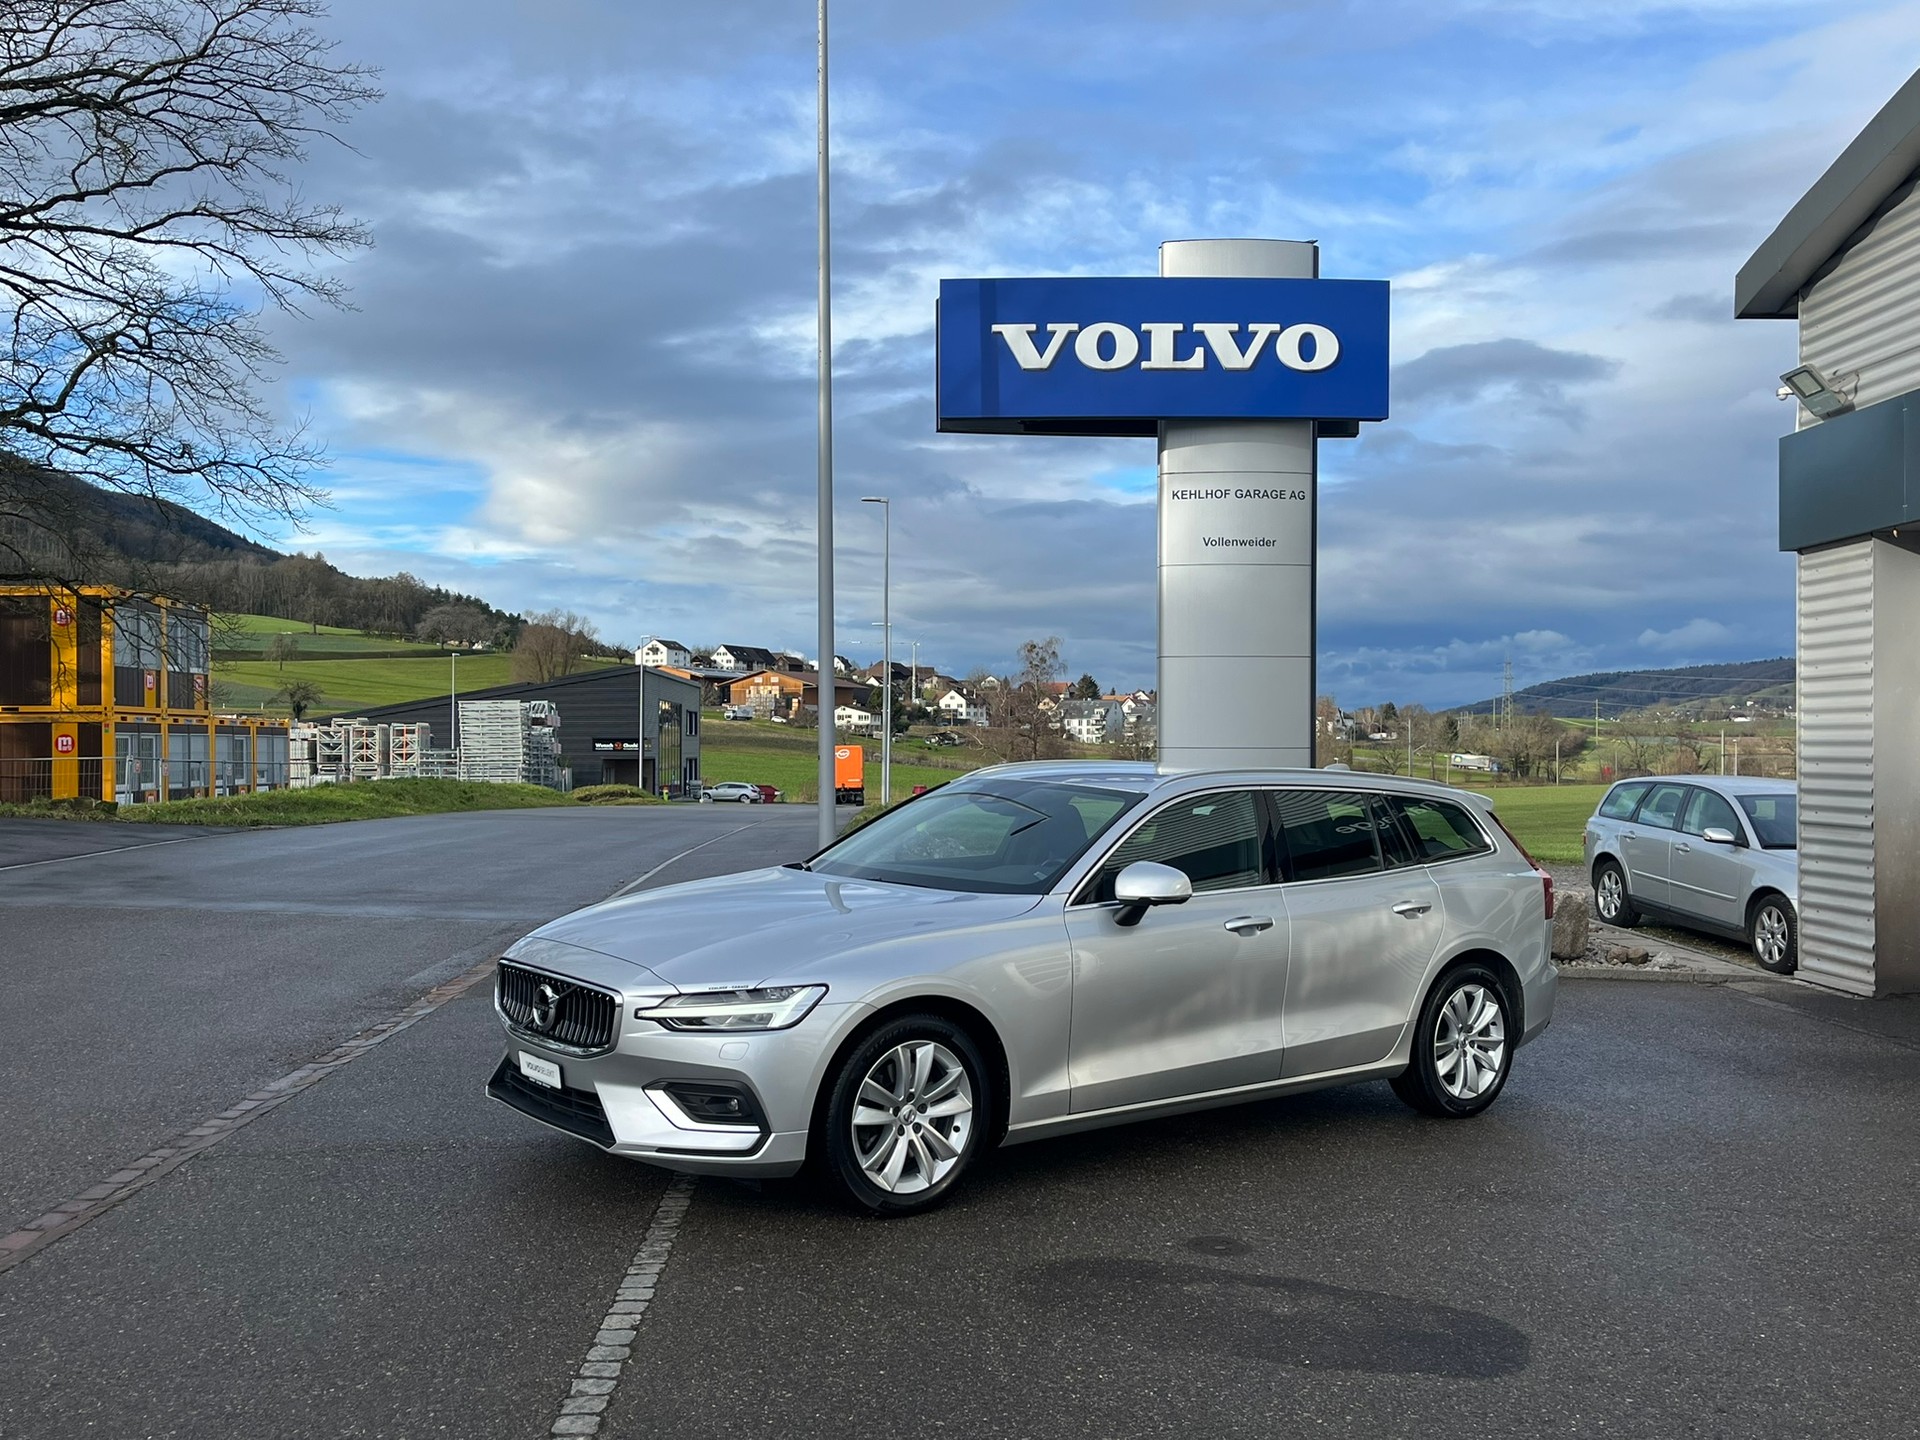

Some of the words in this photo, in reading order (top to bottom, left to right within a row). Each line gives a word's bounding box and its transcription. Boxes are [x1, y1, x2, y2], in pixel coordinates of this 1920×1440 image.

[991, 321, 1340, 371] VOLVO
[1172, 489, 1231, 500] KEHLHOF
[1234, 488, 1286, 500] GARAGE
[1289, 490, 1306, 500] AG
[1202, 537, 1277, 547] Vollenweider
